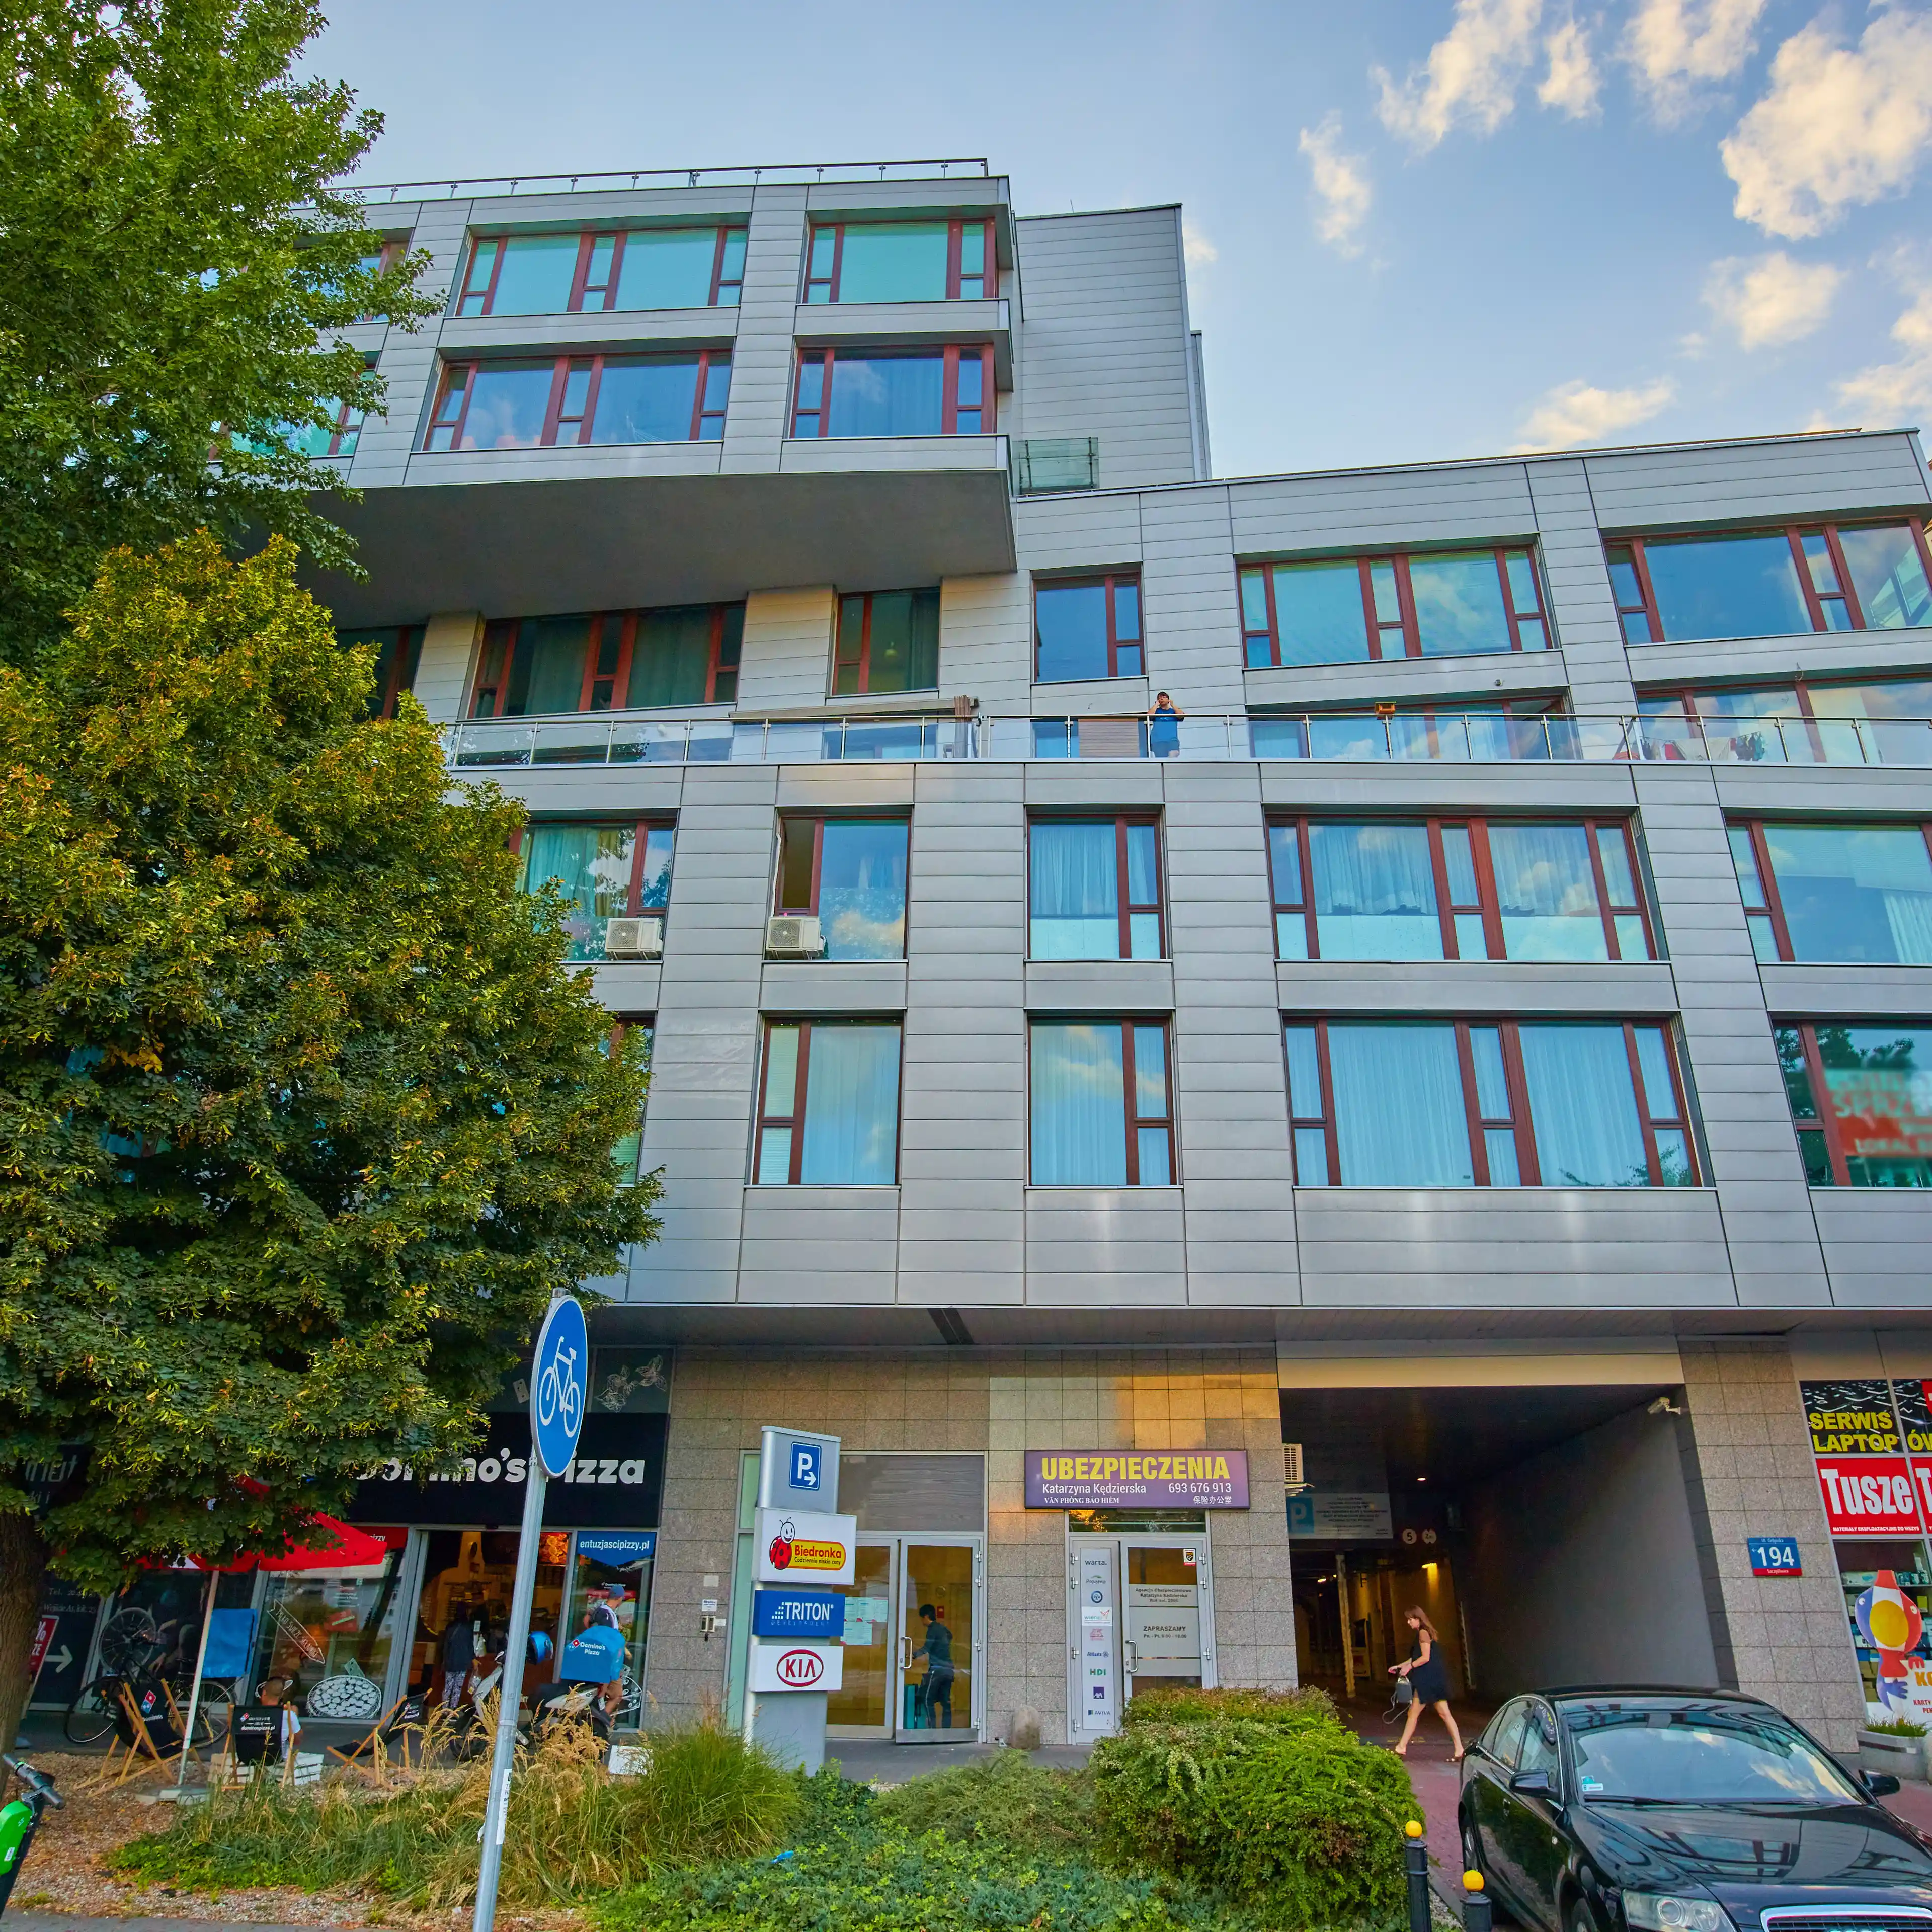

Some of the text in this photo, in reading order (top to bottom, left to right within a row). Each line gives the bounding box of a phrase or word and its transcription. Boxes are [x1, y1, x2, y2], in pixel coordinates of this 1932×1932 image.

[1809, 1412, 1893, 1430] SERWIS
[1813, 1434, 1898, 1452] LAPTOP
[546, 1449, 645, 1484] izza
[797, 1453, 812, 1479] P
[1041, 1457, 1230, 1480] UBEZPIECZENIA
[1042, 1482, 1232, 1496] Katarzyna Kędzierska 693 676 913
[1820, 1469, 1913, 1514] Tusze
[1193, 1496, 1232, 1504] 保险办公室
[580, 1540, 650, 1550] entuzjascipizzy.pl
[795, 1545, 841, 1558] Biedronka
[1757, 1546, 1795, 1566] 194
[785, 1602, 830, 1620] TRITON
[580, 1642, 606, 1650] Domino's
[785, 1659, 816, 1678] KIA
